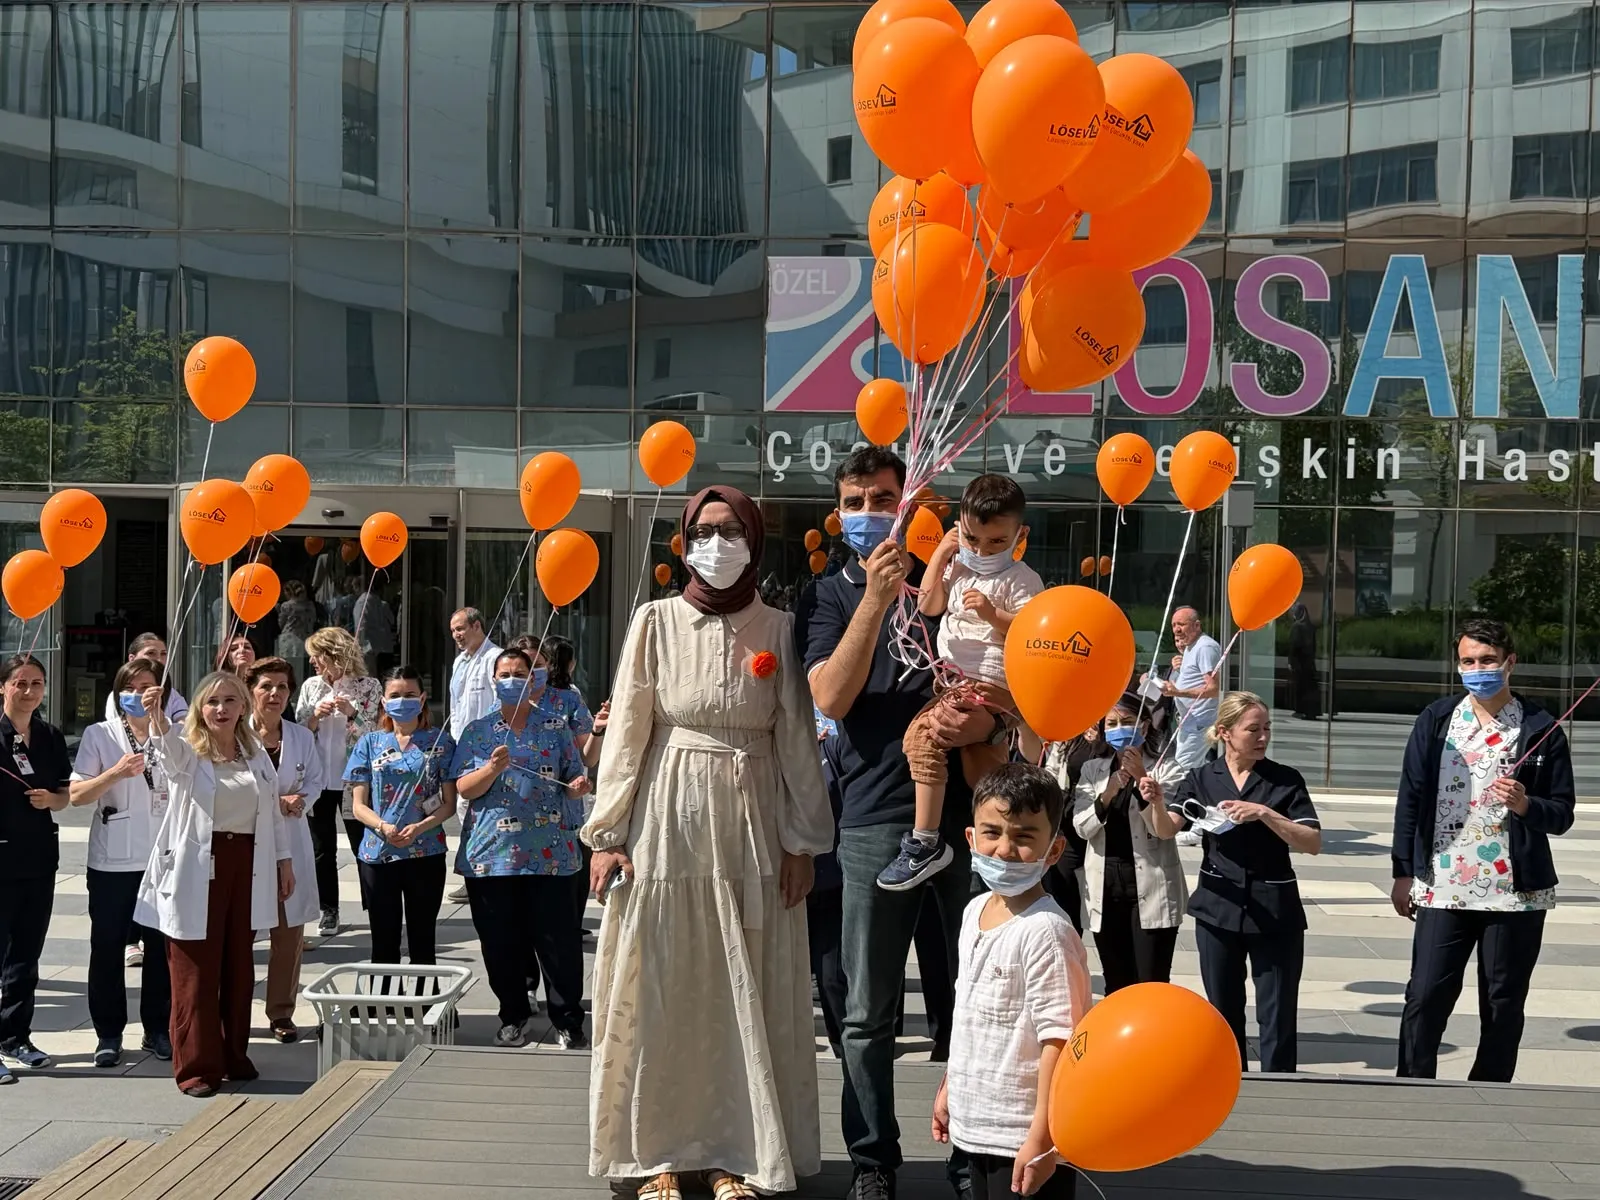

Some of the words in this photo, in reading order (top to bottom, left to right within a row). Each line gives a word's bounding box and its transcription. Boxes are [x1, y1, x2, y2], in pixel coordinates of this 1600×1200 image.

[1049, 123, 1090, 139] LÖSEV
[1103, 109, 1135, 132] SEV
[771, 263, 836, 296] ÖZEL
[1075, 326, 1108, 356] LÖSEV
[766, 430, 955, 482] Çok
[1003, 442, 1067, 476] ve
[1110, 435, 1401, 488] eişkin
[1026, 638, 1070, 652] LÖSEV
